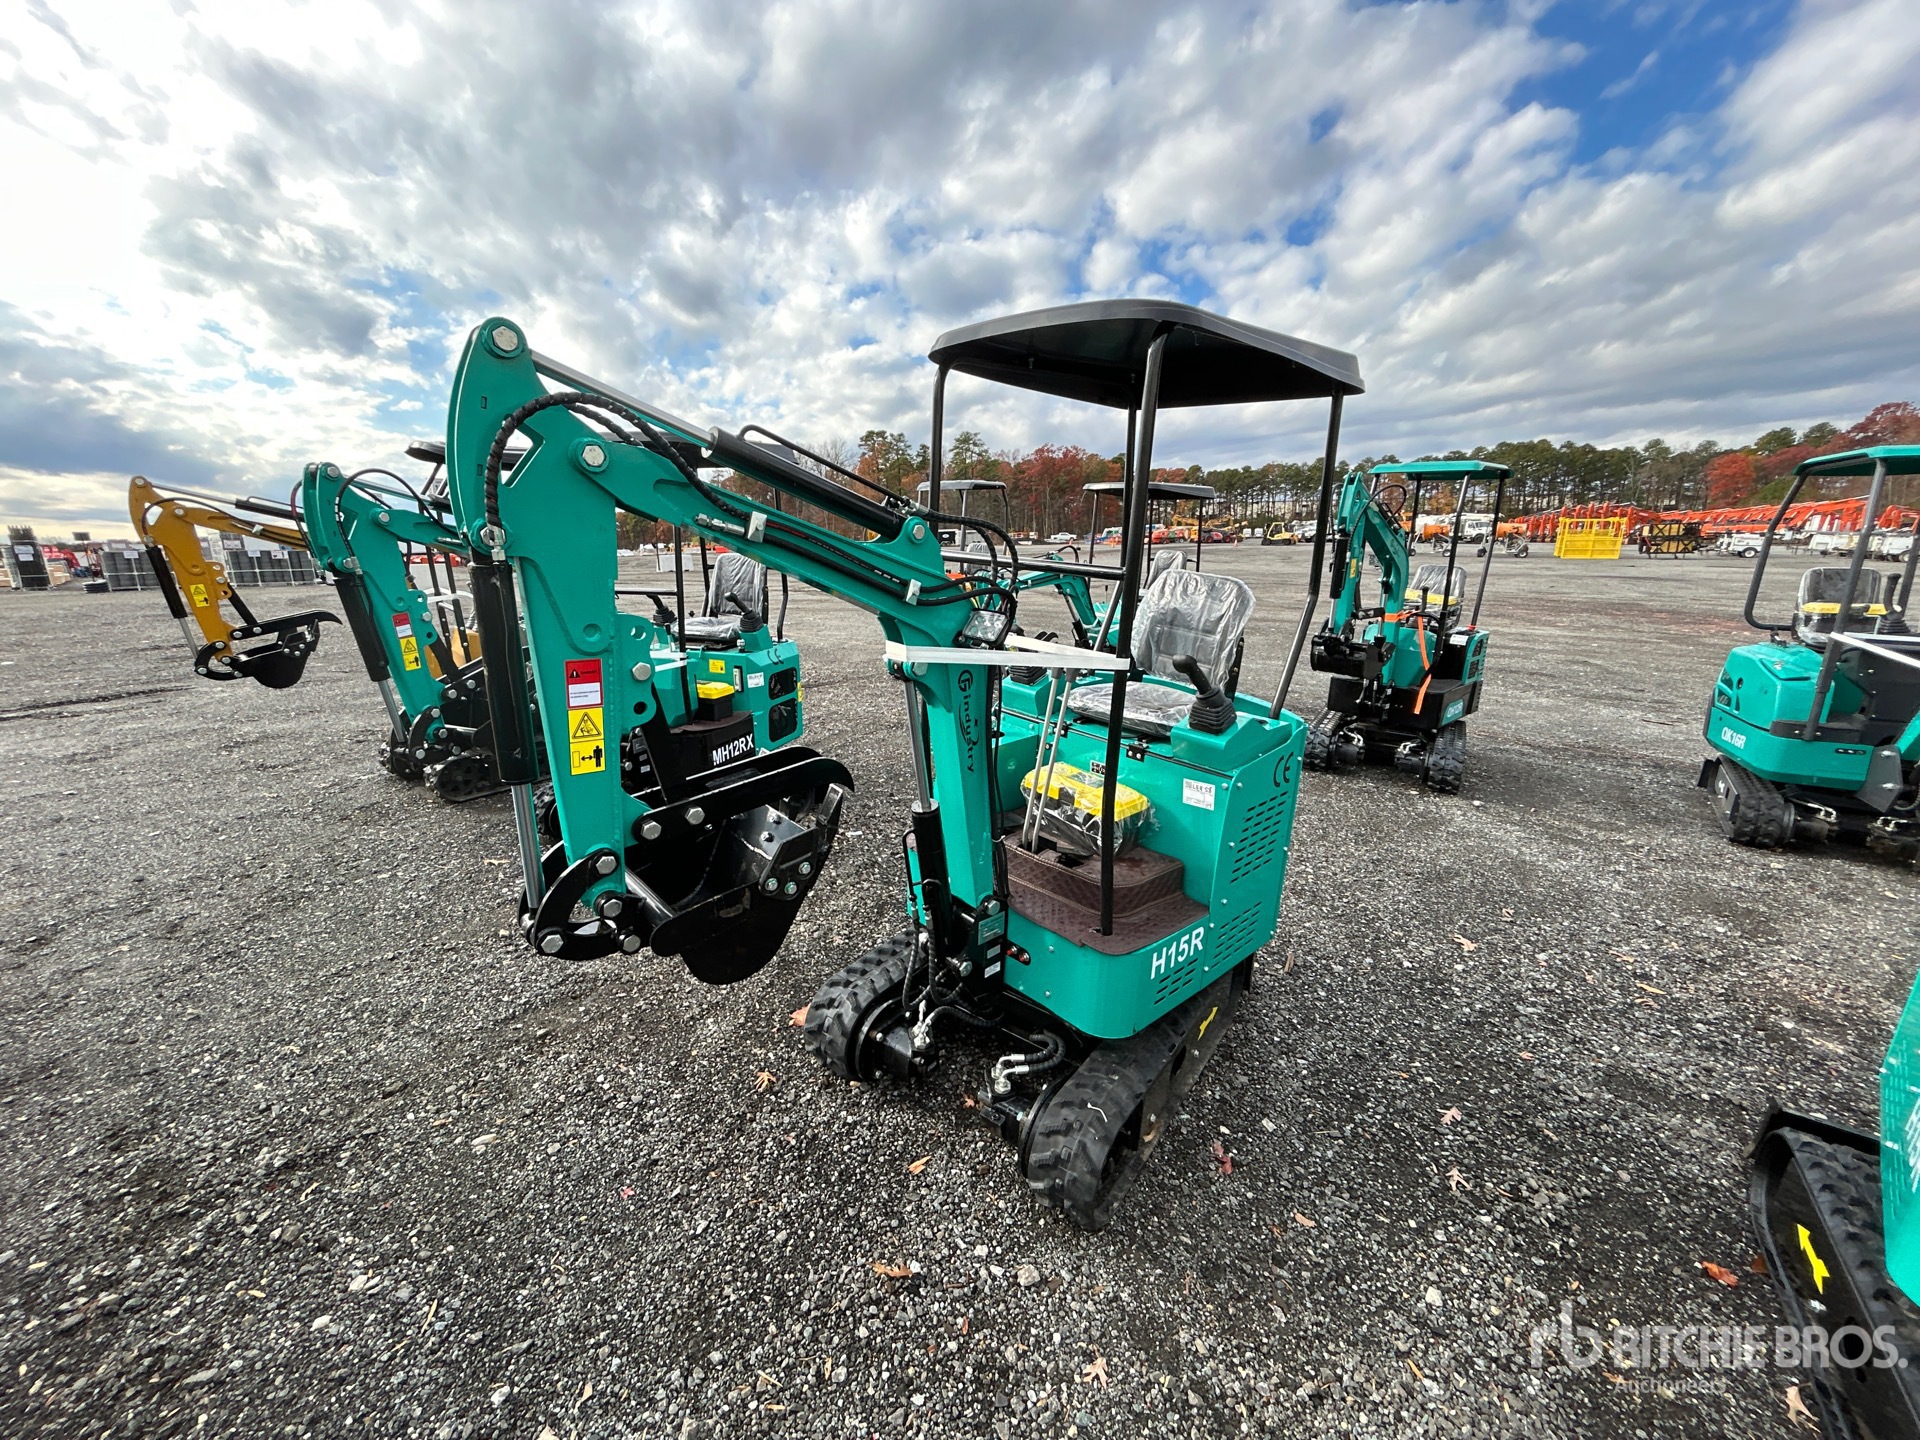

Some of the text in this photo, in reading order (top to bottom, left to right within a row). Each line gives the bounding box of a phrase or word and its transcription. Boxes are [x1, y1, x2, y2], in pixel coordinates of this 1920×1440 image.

[712, 733, 754, 766] MH12RX
[1273, 751, 1294, 788] CE
[1150, 926, 1205, 980] H15R
